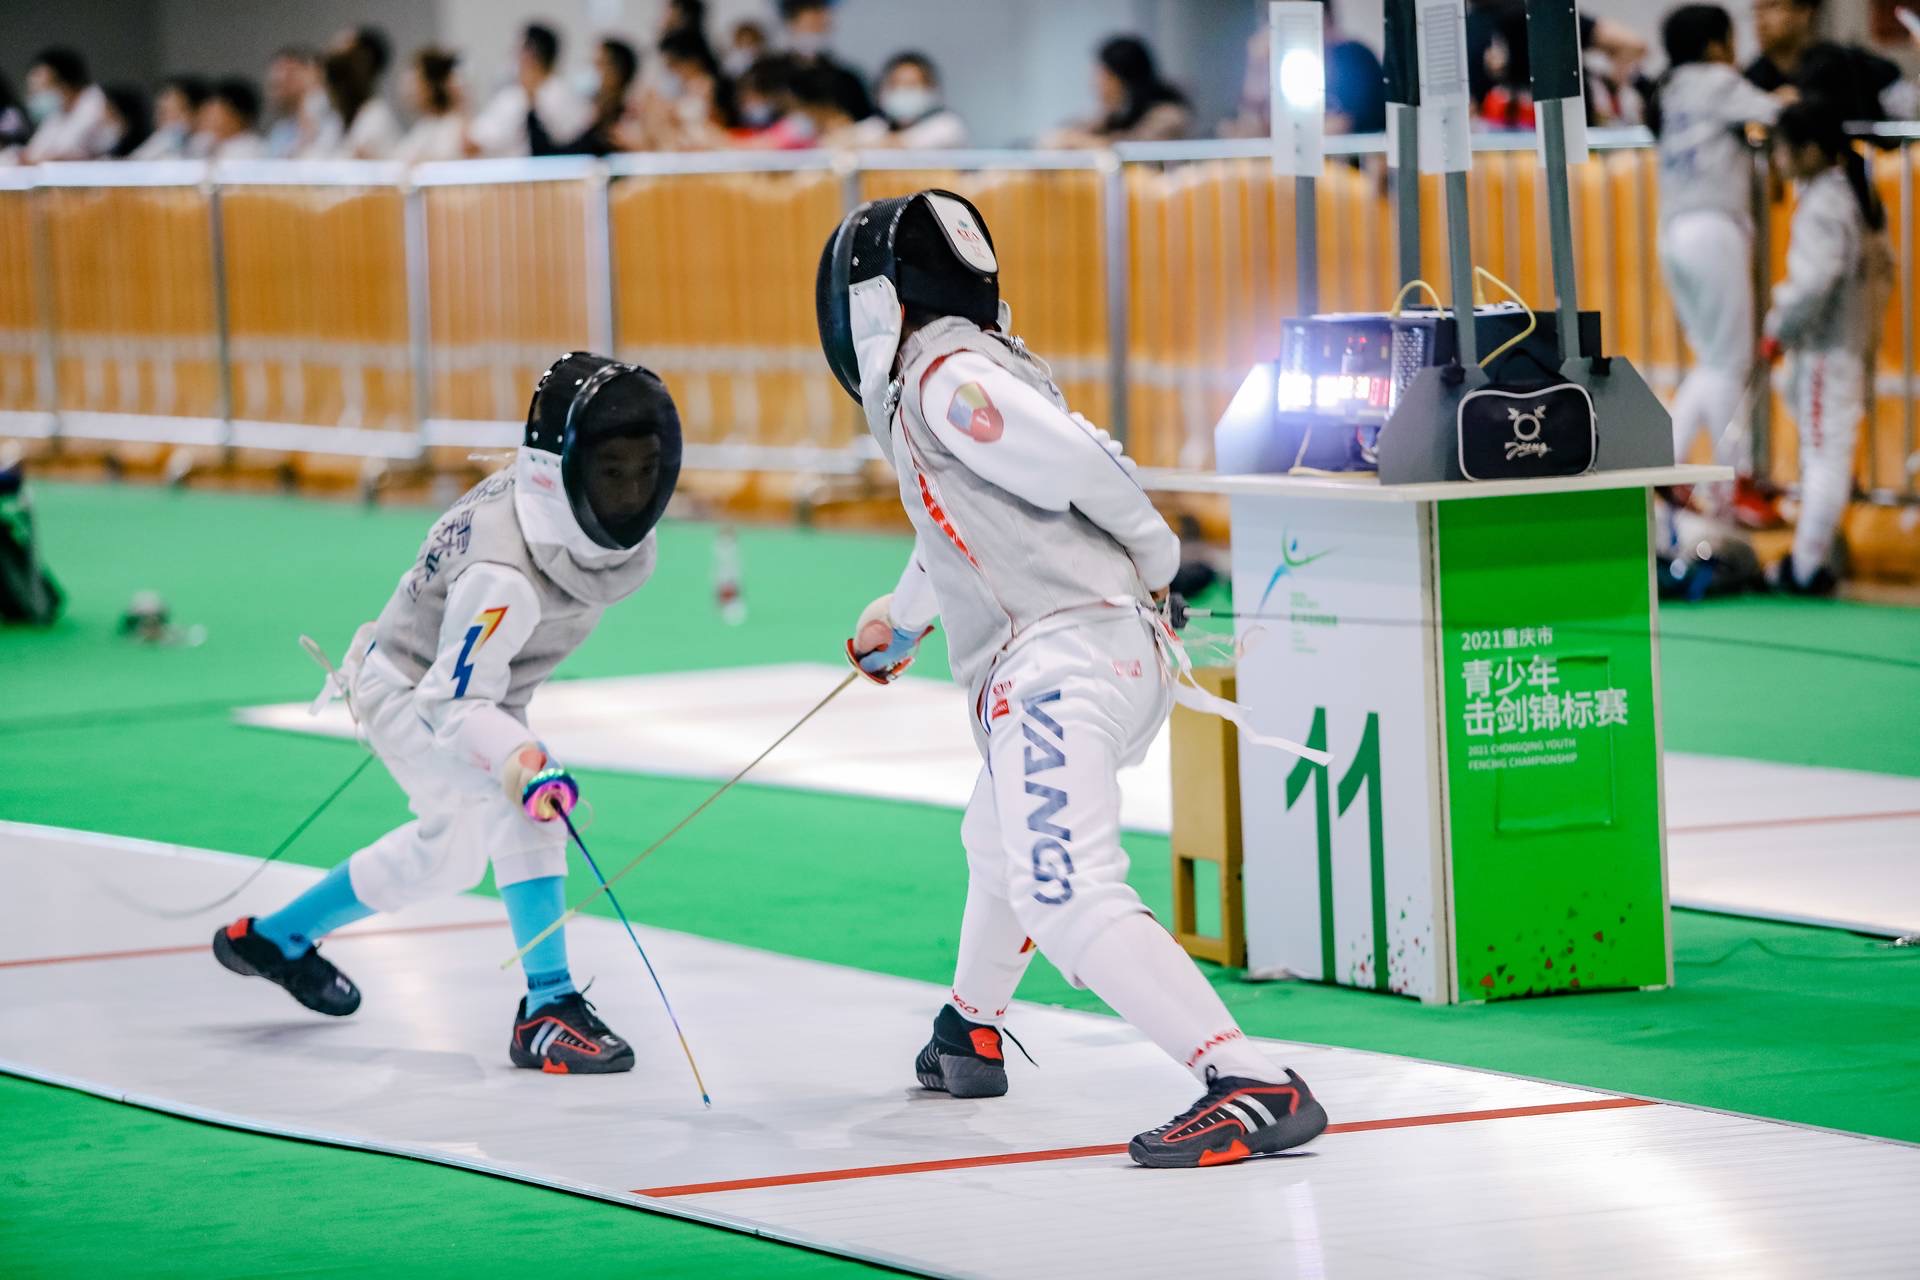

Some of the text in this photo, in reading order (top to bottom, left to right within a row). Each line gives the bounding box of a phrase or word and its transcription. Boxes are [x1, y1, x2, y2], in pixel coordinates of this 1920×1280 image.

[1461, 625, 1553, 651] 2021重庆市
[1461, 654, 1560, 699] 青少年
[1463, 687, 1628, 736] 击剑锦标赛
[1468, 737, 1577, 758] 2021 CHONGQING YOUTH
[1468, 752, 1578, 771] FENCING CHAMPIONSHIP
[1285, 706, 1389, 990] 11
